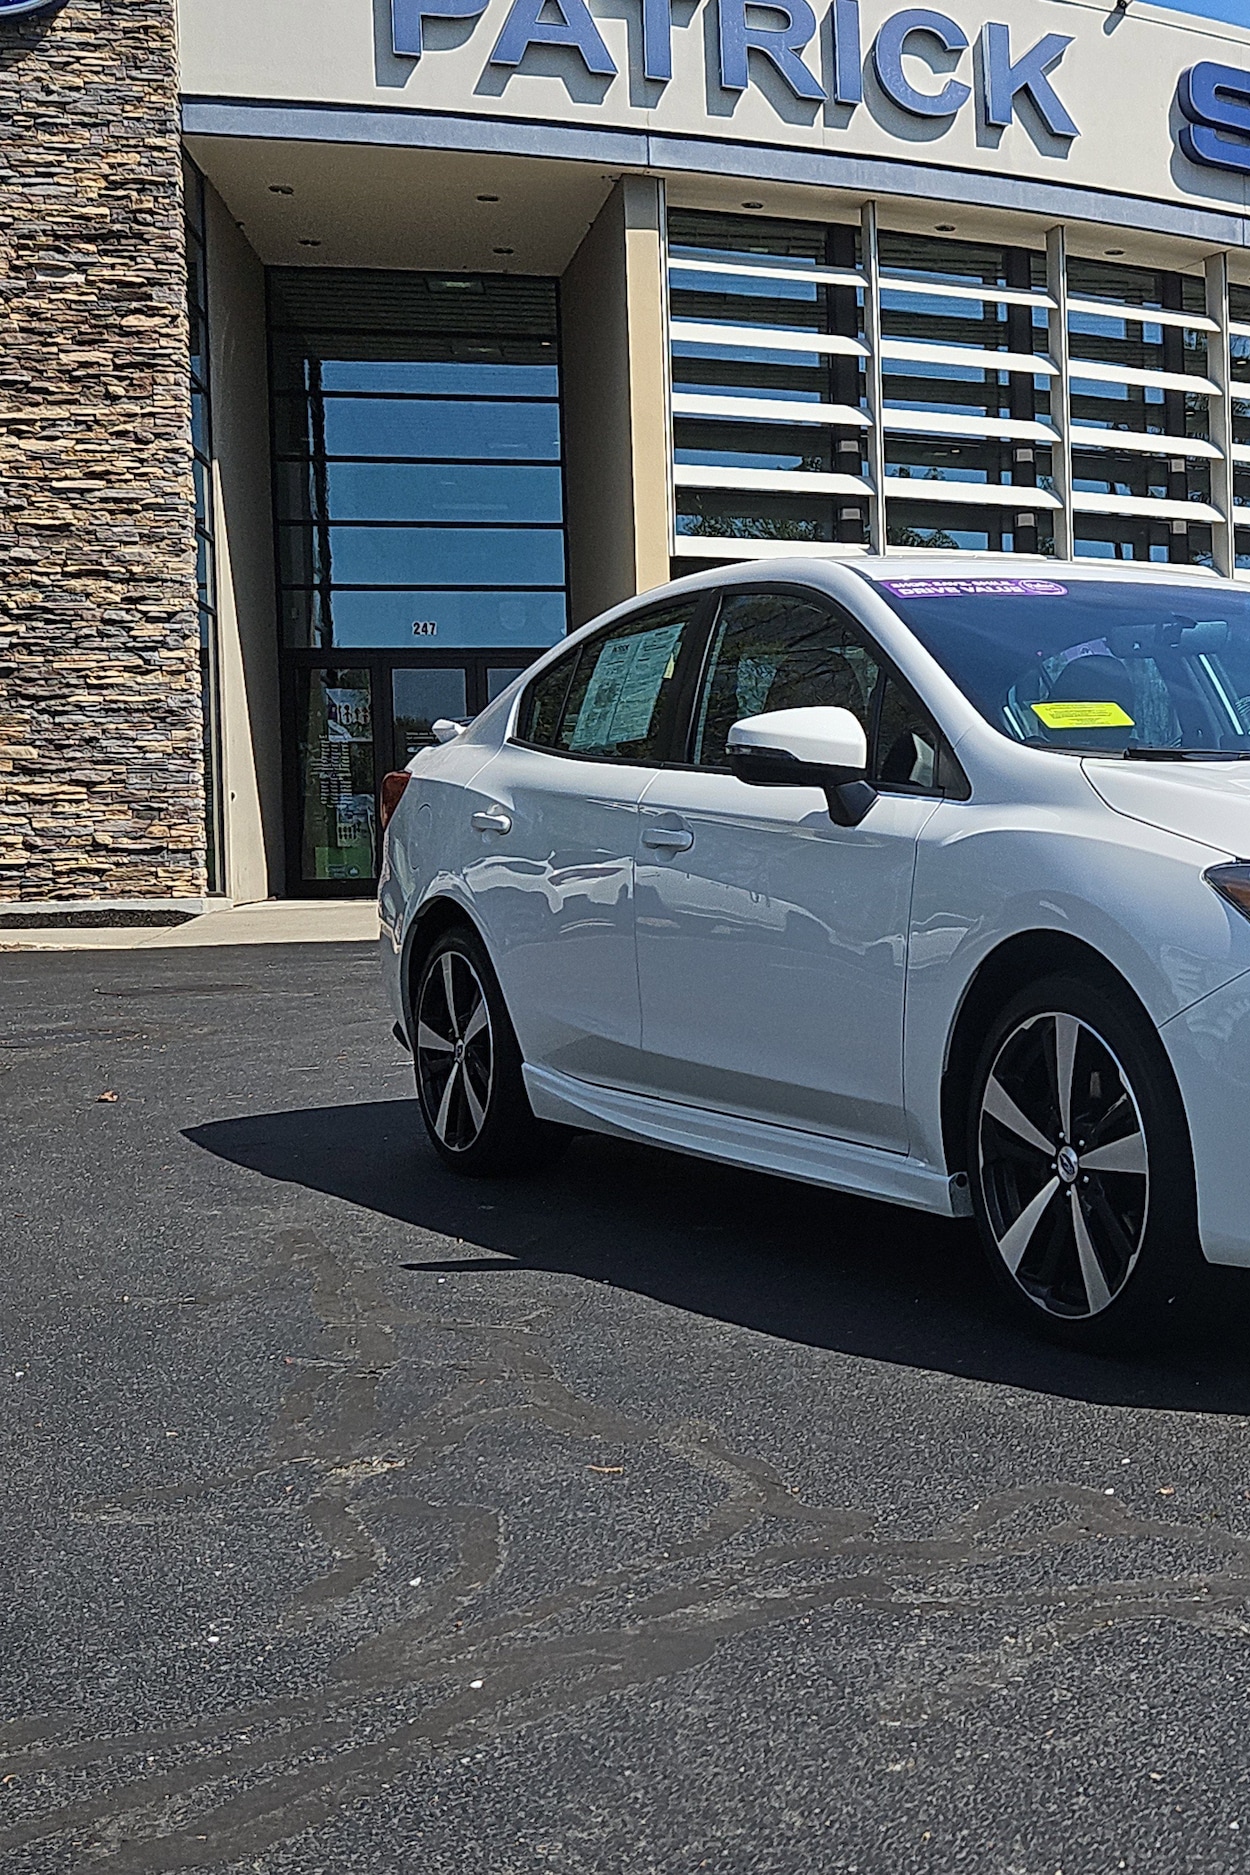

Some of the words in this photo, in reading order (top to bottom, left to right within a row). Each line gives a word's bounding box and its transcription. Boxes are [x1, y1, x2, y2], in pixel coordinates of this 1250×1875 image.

[898, 586, 960, 595] DRIVE
[961, 585, 1025, 594] VALUE
[413, 622, 436, 635] 247
